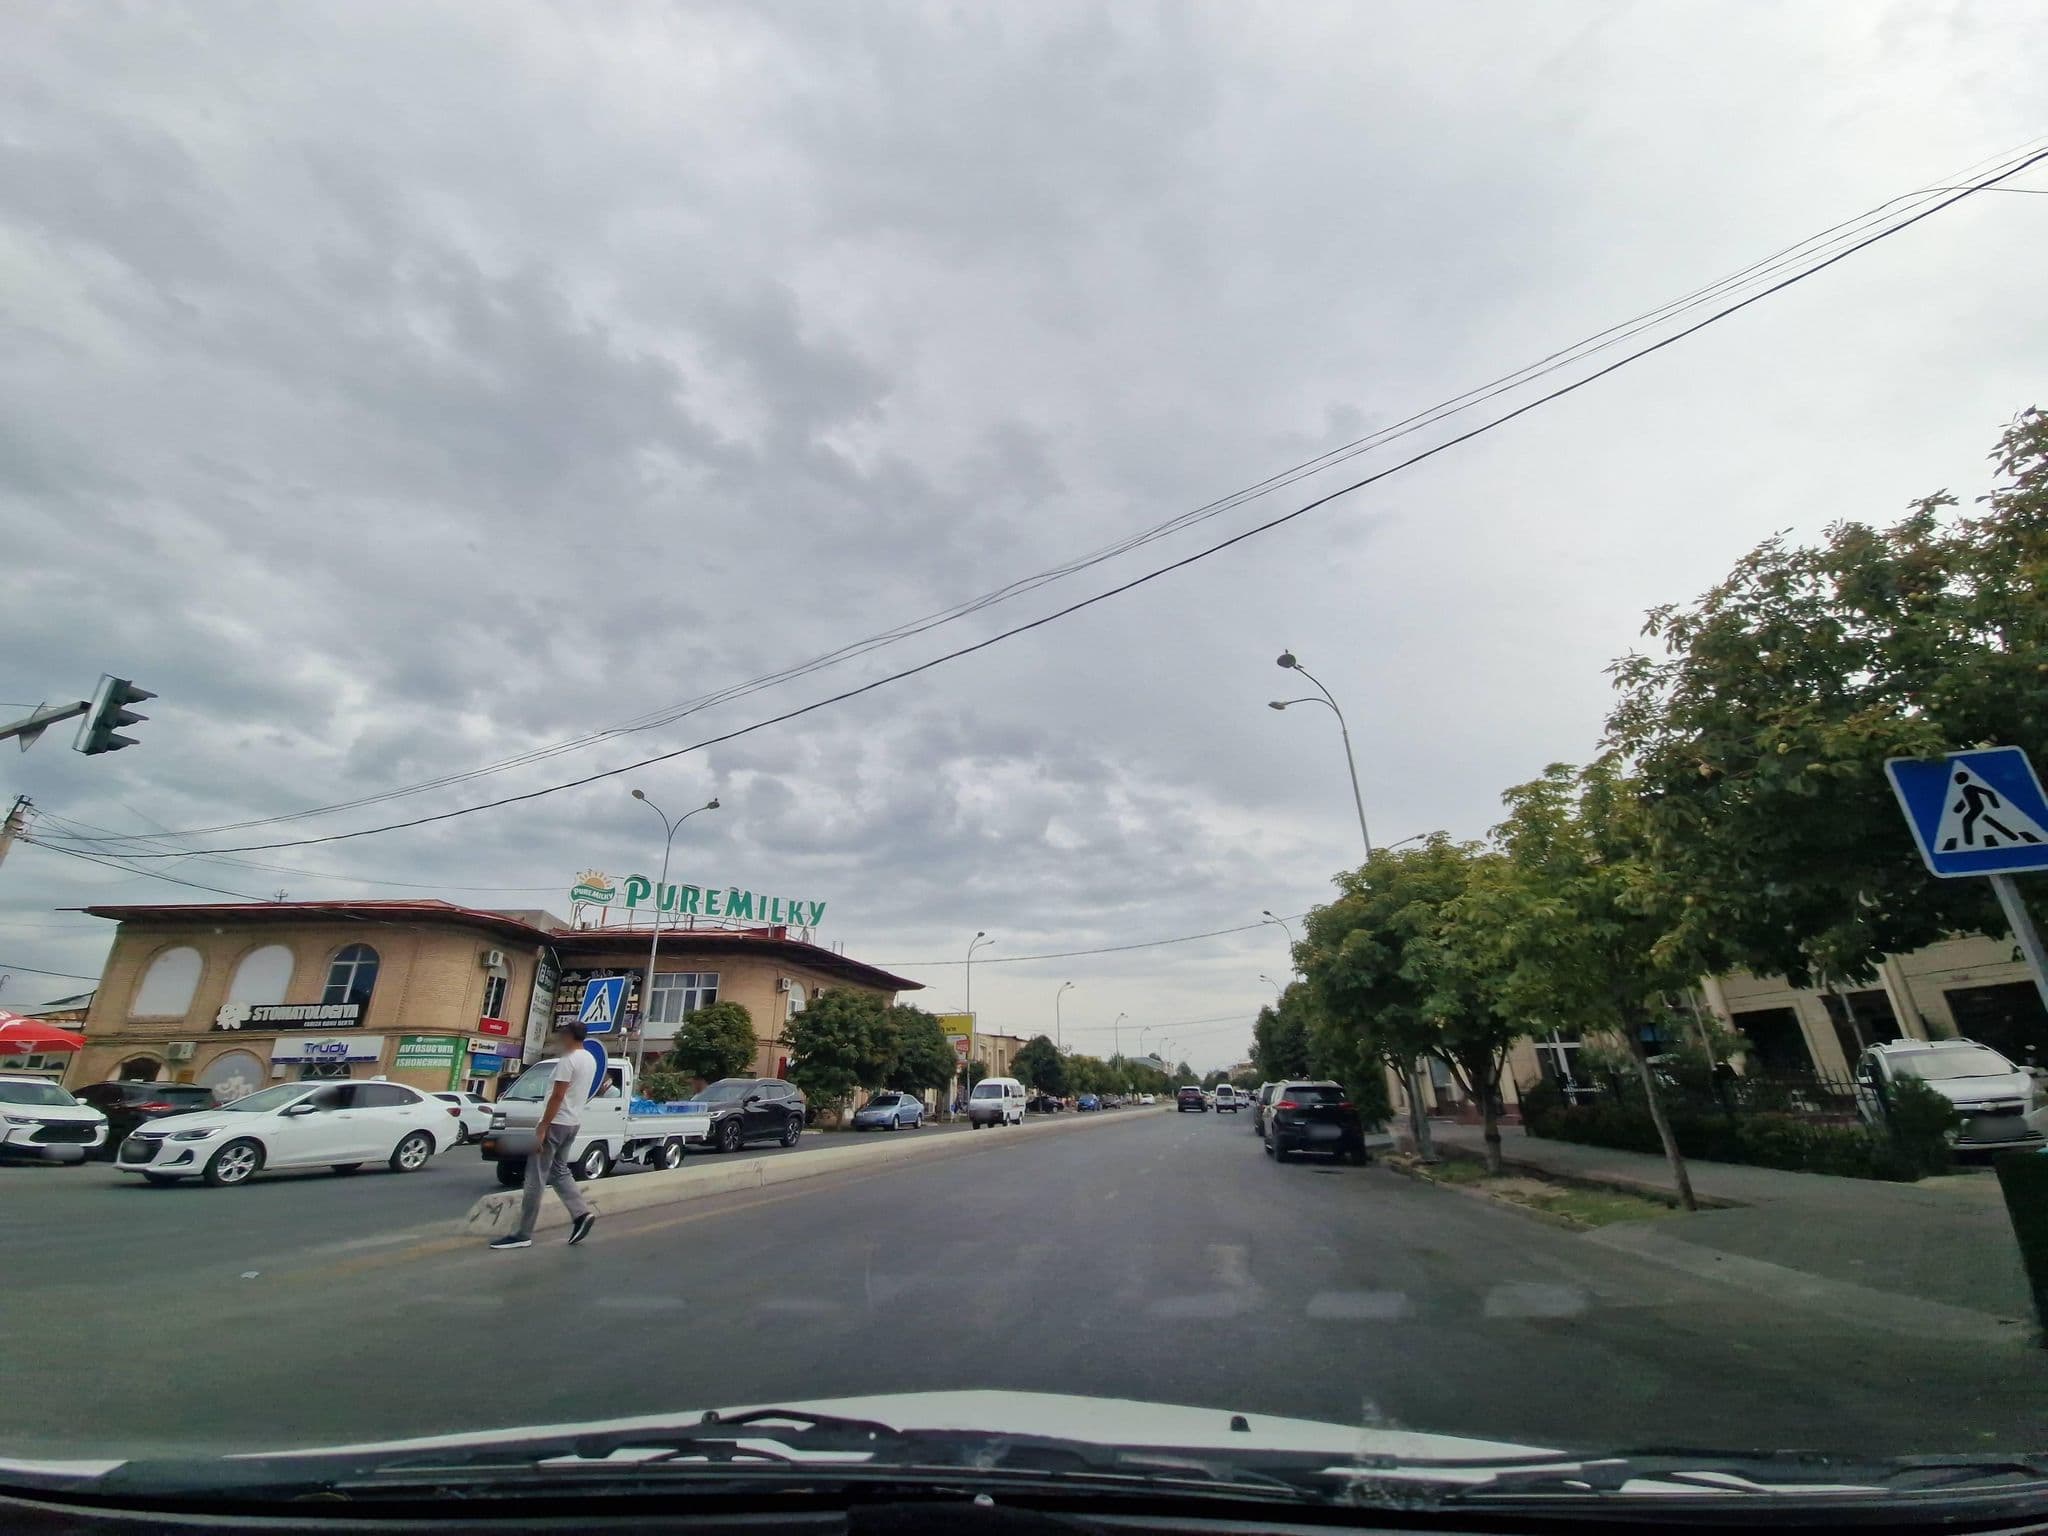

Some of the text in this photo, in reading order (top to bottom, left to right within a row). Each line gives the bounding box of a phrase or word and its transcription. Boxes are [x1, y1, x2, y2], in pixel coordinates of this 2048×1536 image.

[574, 887, 614, 901] PUREMILKY
[623, 874, 827, 928] PUREMILKY
[252, 1004, 359, 1021] STOMATOLOGIYA
[304, 1042, 349, 1055] Trudy
